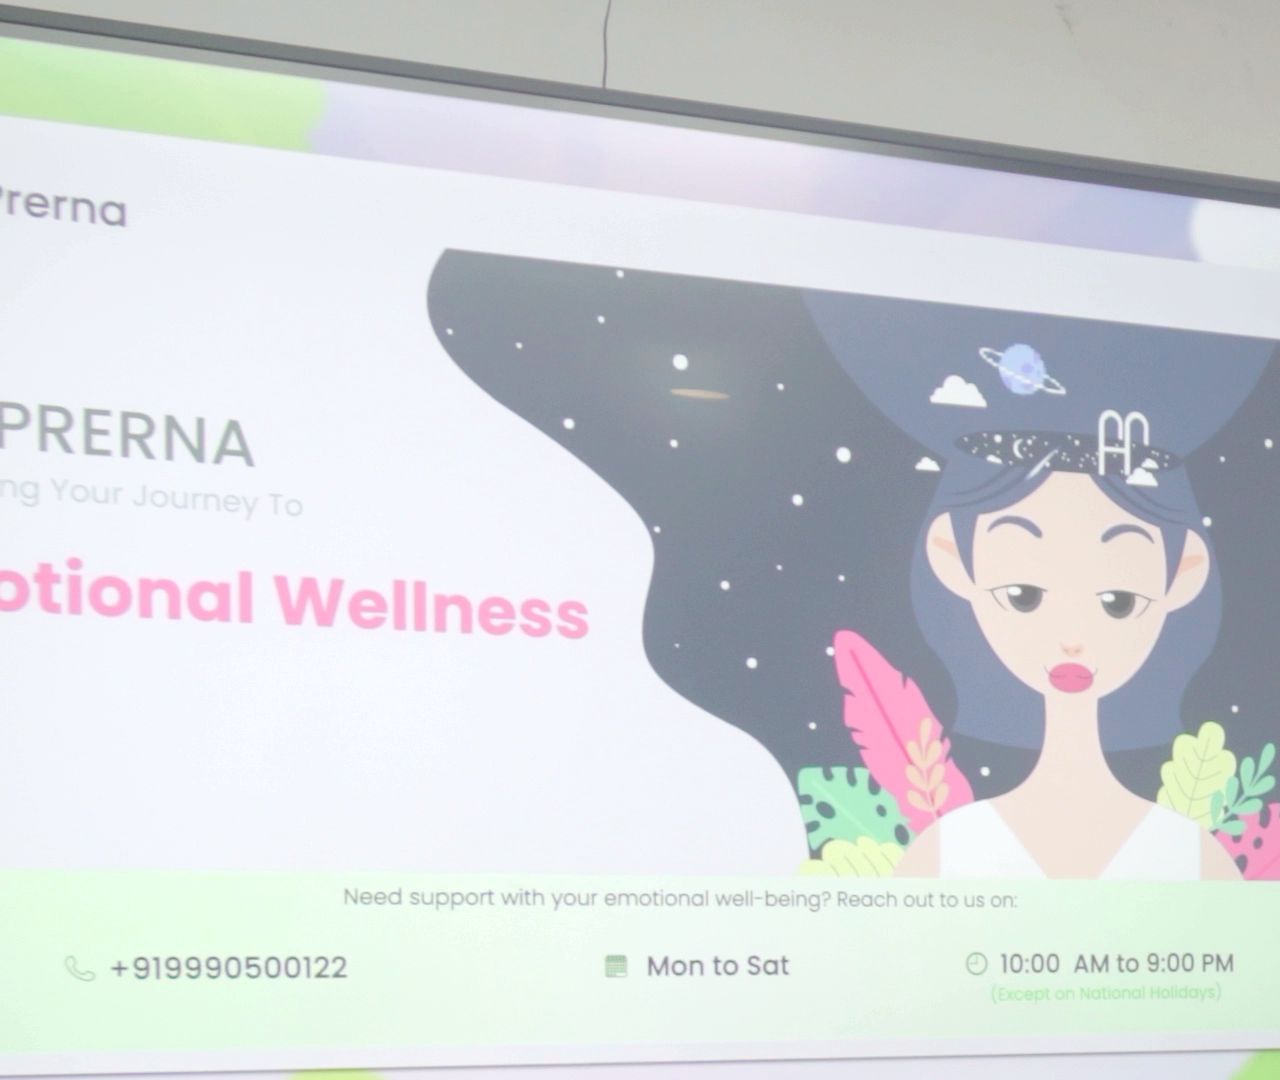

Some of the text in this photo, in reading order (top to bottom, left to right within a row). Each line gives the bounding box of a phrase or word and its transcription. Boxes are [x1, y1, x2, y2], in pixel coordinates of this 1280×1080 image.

[0, 185, 126, 227] rerna
[0, 401, 255, 467] PRERNA
[50, 477, 123, 505] Your
[132, 484, 258, 521] Journey
[268, 493, 304, 517] To
[273, 574, 590, 639] Wellness
[343, 888, 1018, 912] Need support with your emotional well-being? Reach out to us on:
[110, 955, 348, 981] +919990500122
[647, 955, 790, 976] Mon to Sat
[1000, 952, 1234, 974] 10:00 AM to 9:00 PM
[991, 982, 1222, 1004] (Except on National Holidays)
